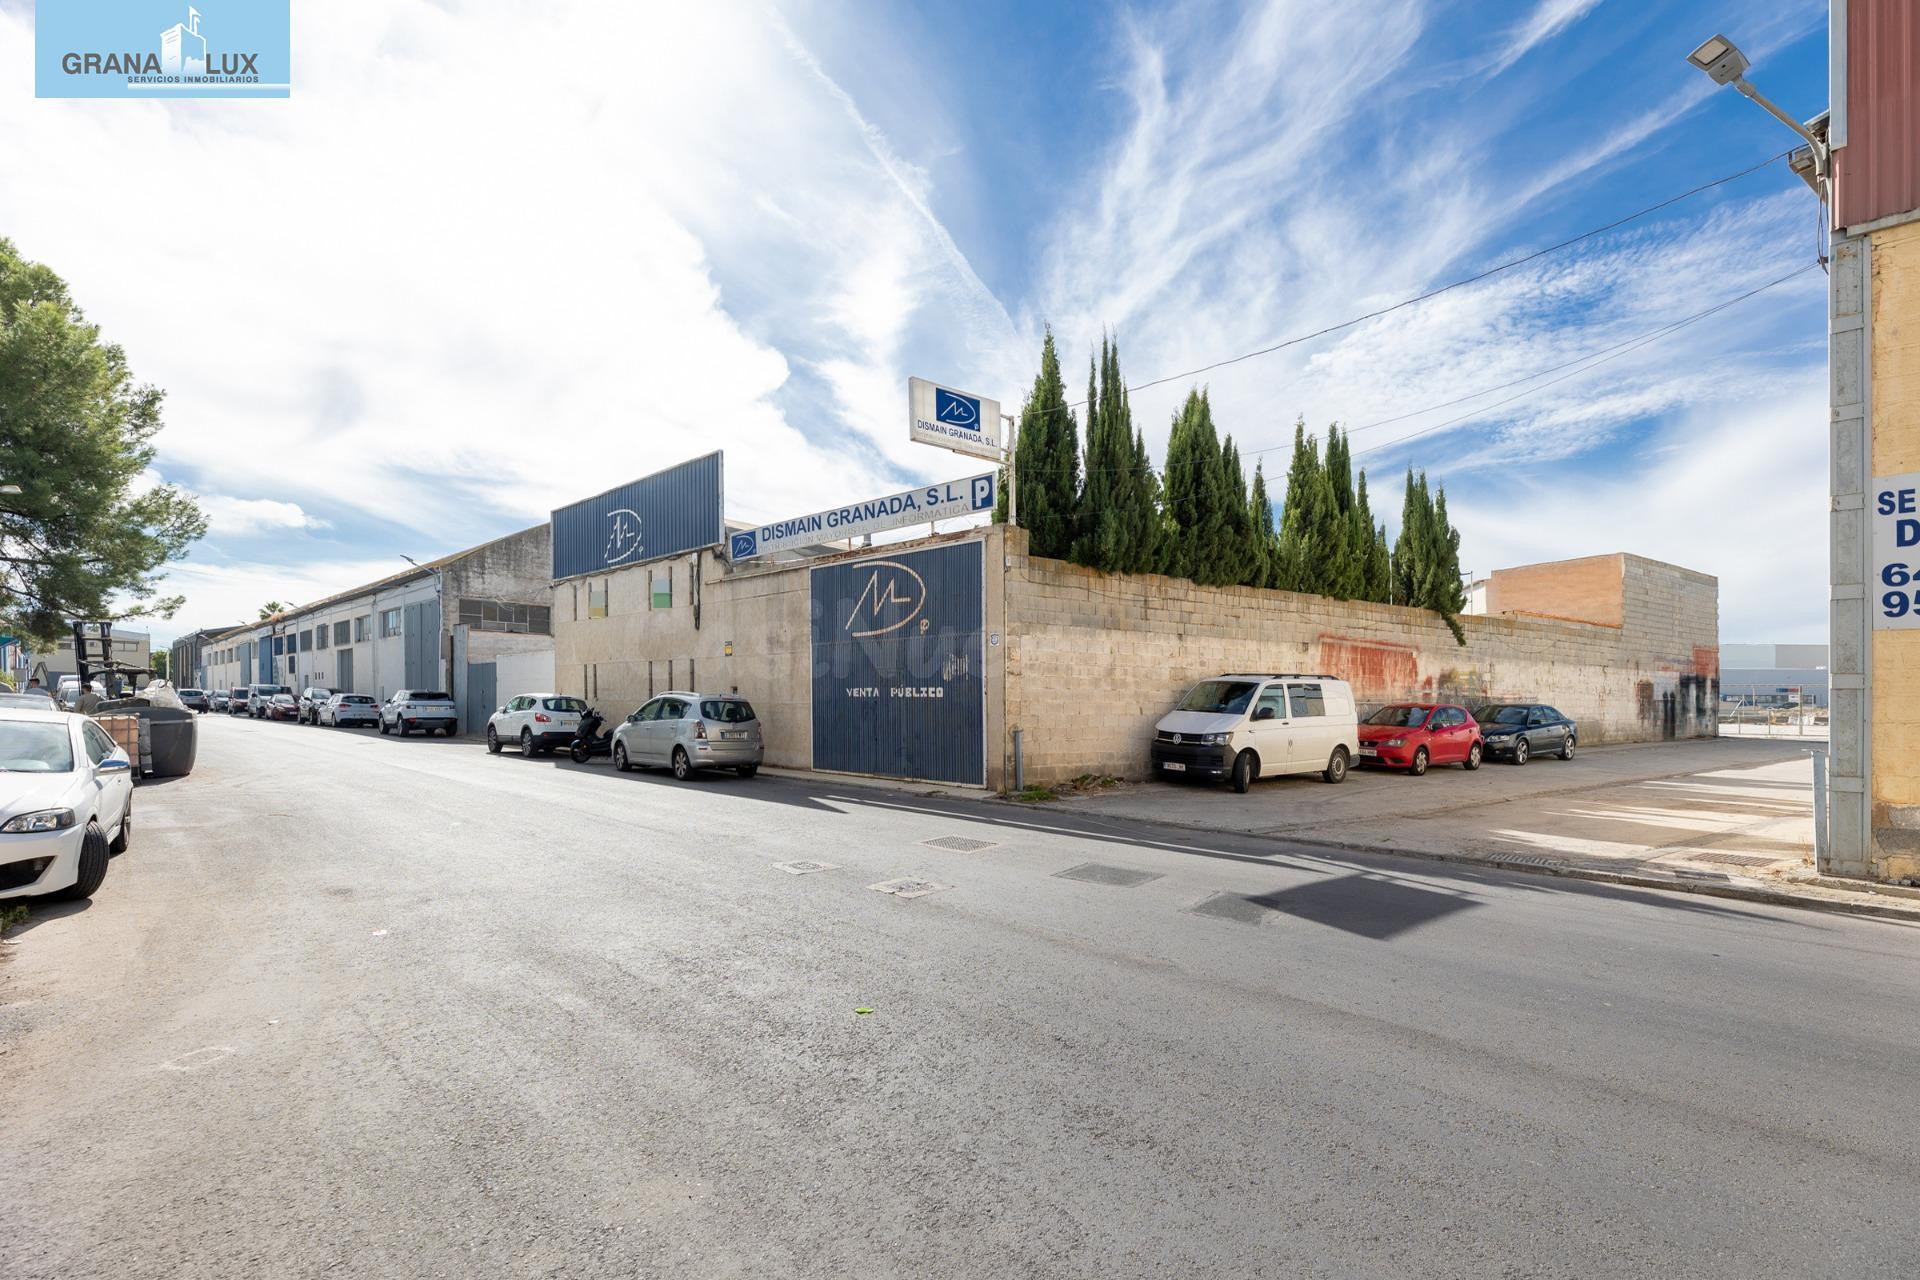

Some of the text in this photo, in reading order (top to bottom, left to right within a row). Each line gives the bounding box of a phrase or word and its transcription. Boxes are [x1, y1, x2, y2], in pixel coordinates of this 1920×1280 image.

[917, 419, 947, 435] DISMAIN
[762, 485, 963, 542] DISMAIN GRANADA, S.L.
[1877, 488, 1916, 516] SE
[1881, 563, 1920, 588] 6
[1881, 590, 1920, 618] 9
[846, 687, 879, 698] VENTA
